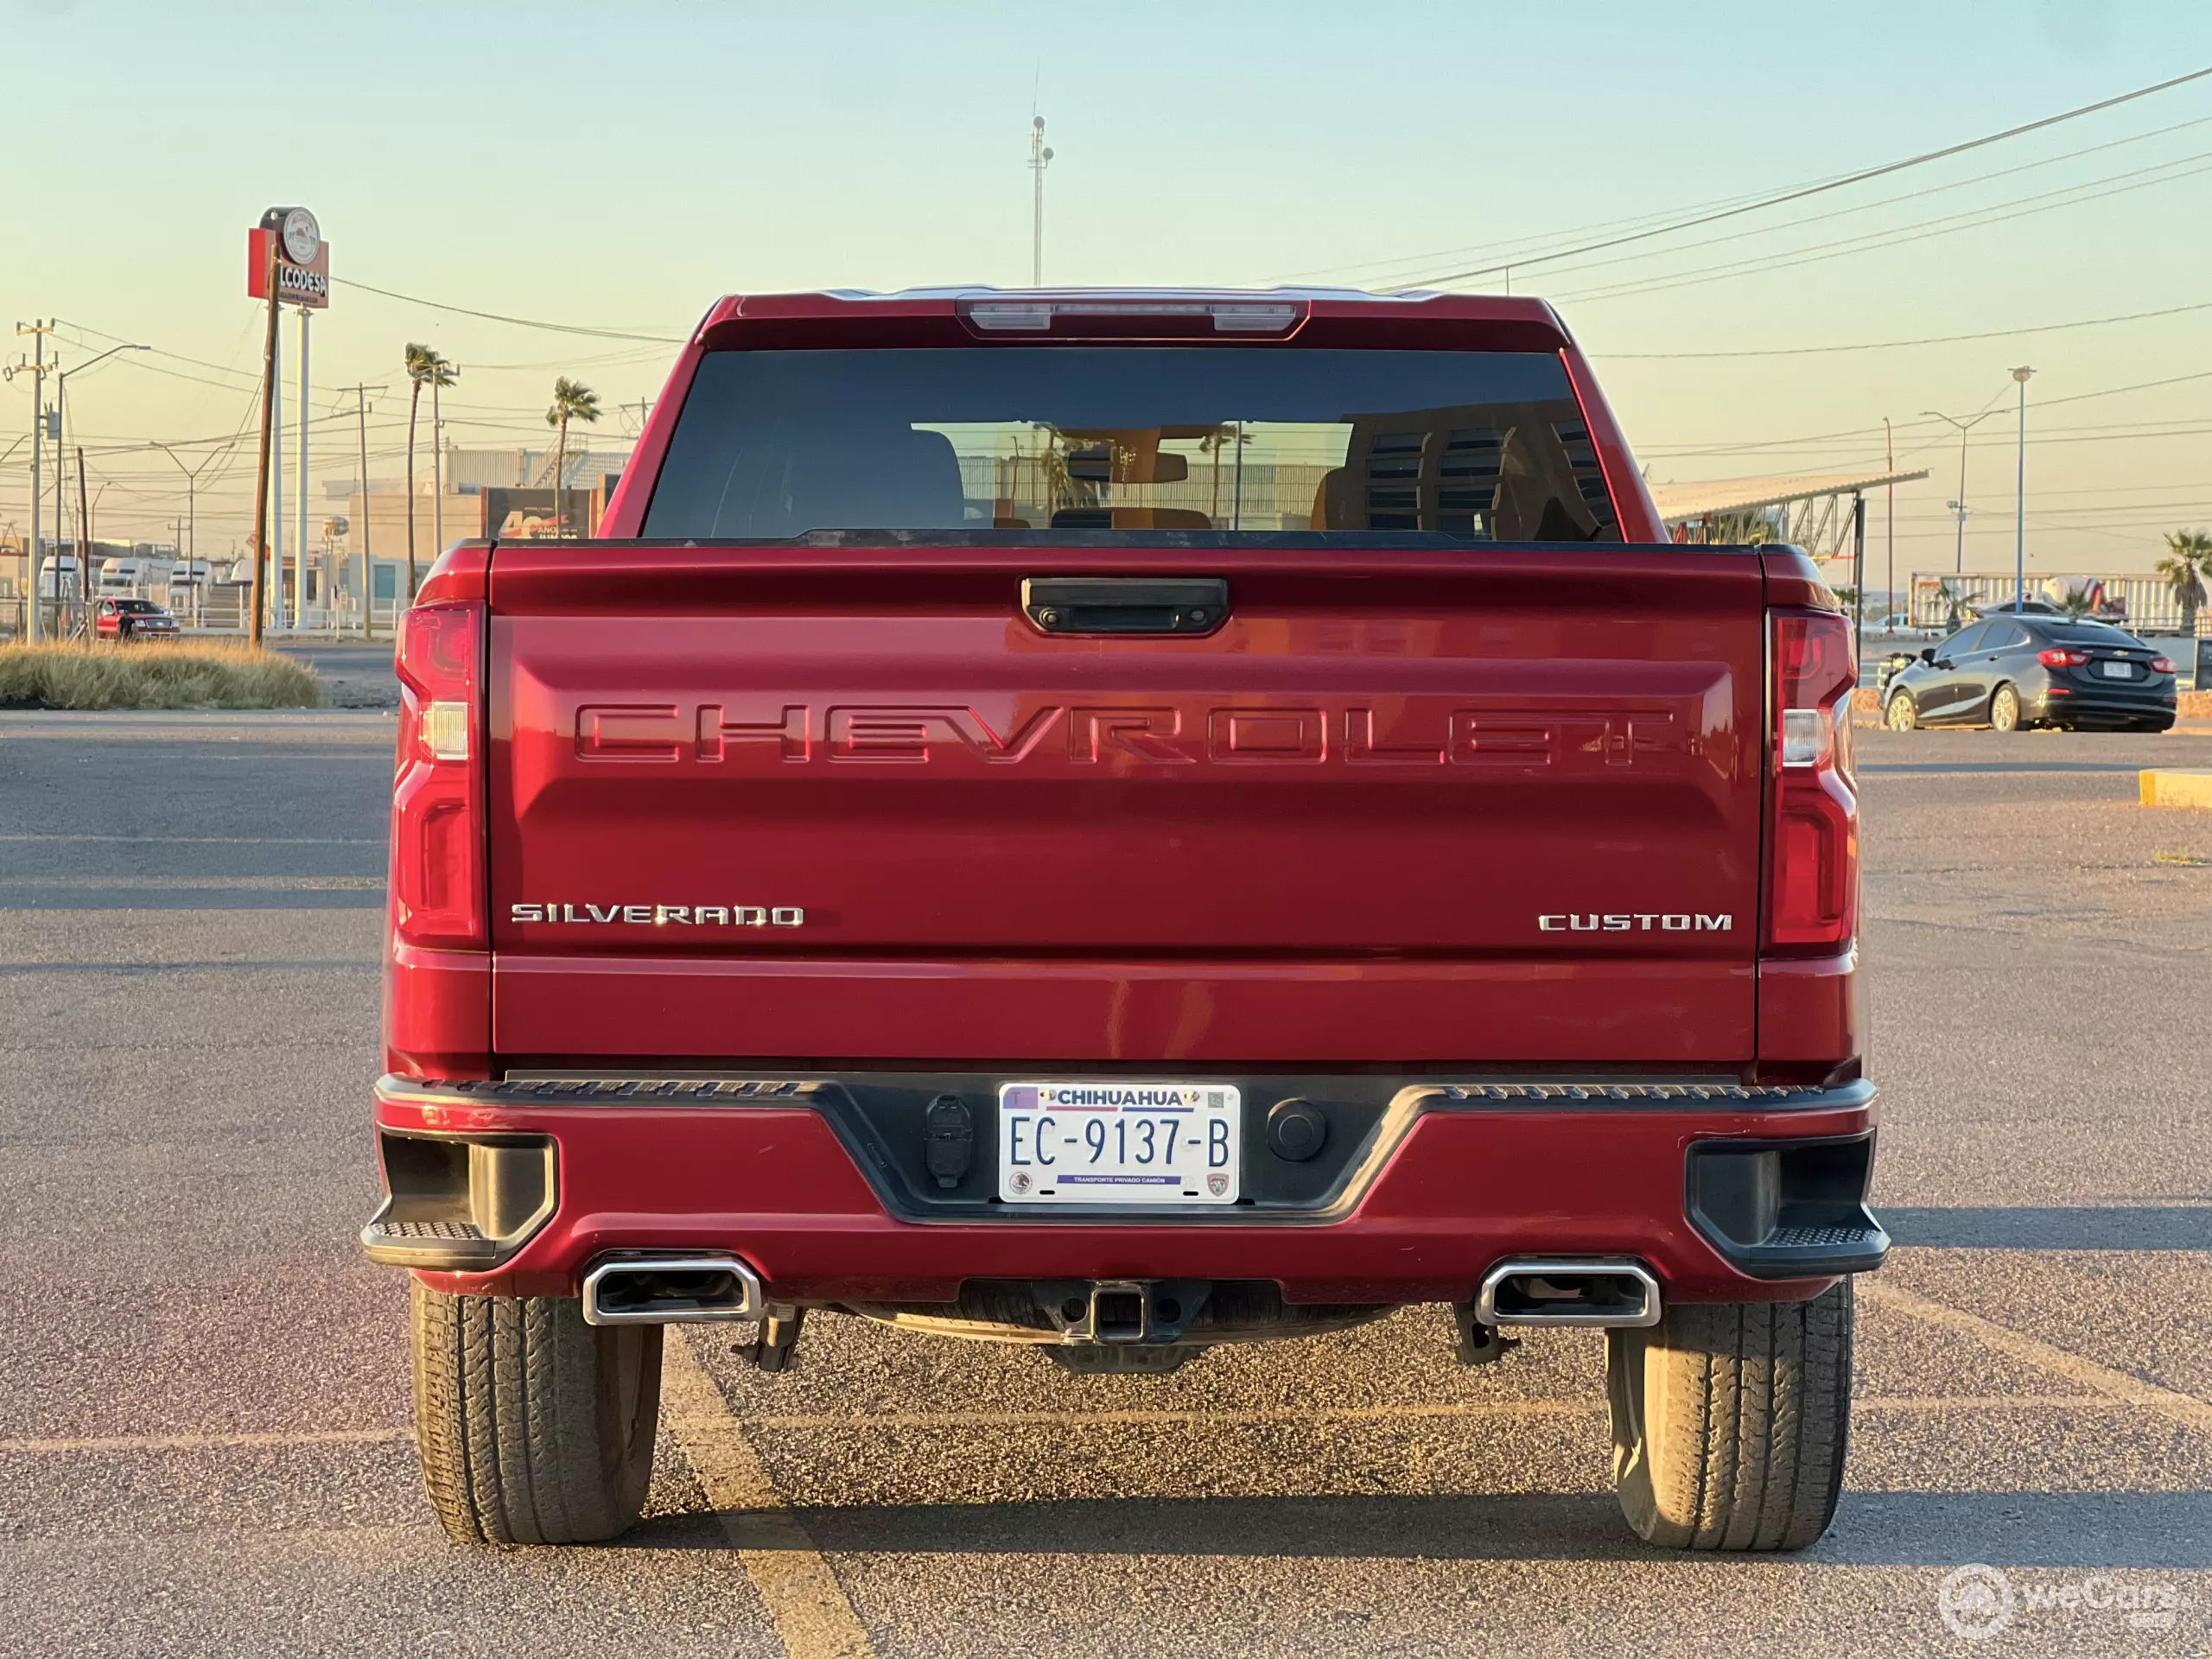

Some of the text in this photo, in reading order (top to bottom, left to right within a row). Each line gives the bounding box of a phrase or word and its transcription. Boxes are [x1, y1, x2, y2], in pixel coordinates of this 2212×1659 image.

[280, 265, 327, 297] LCODESA
[575, 703, 1675, 767] CHEVROLET
[511, 904, 805, 927] SILVERADO
[1537, 913, 1733, 932] CUSTOM
[1058, 1090, 1183, 1106] CHIHUAHUA
[1010, 1116, 1230, 1167] EC-9137-B
